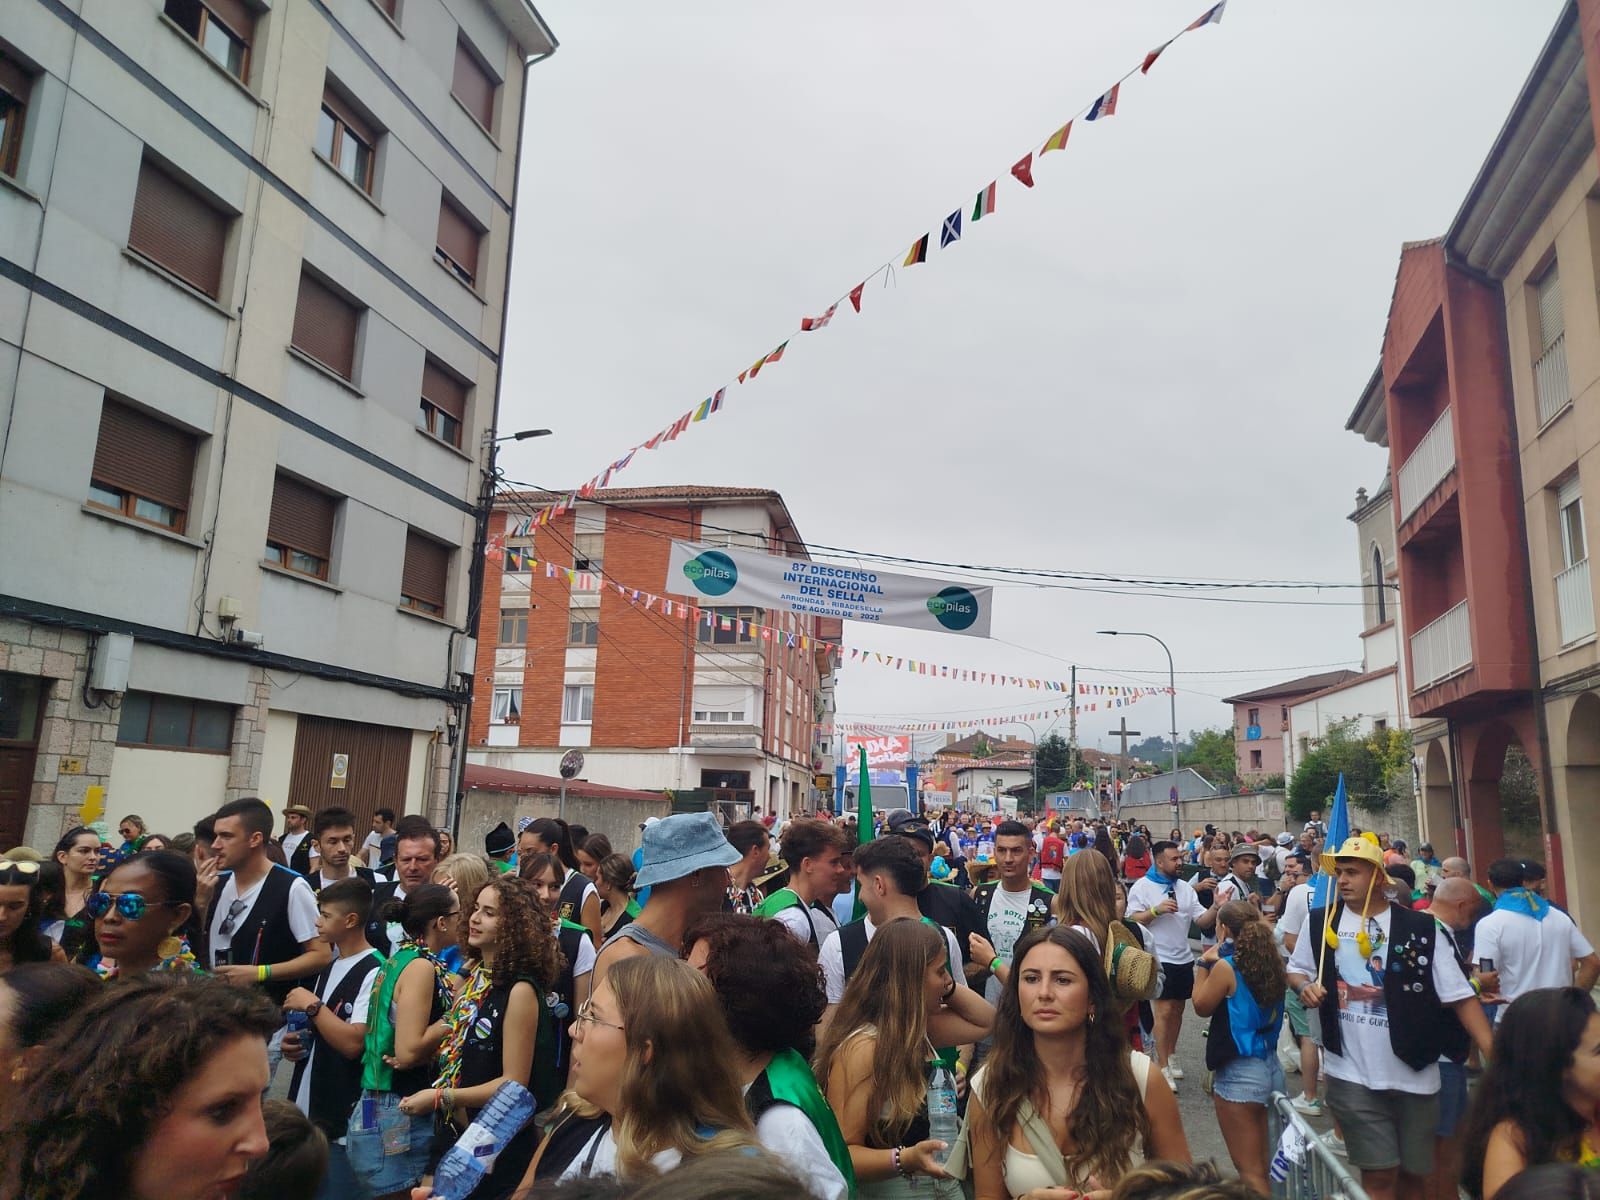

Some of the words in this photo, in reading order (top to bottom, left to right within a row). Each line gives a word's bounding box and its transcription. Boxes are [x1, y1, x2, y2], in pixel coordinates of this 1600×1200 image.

[683, 565, 730, 579] ecopilas
[792, 562, 807, 572] 87
[810, 565, 877, 583] DESCENSO
[783, 572, 884, 594] INTERNACIONAL
[780, 593, 825, 606] ARRIONDAS
[831, 601, 883, 613] RIBADESELLA
[800, 585, 823, 597] DEL
[827, 589, 865, 603] SELLA
[808, 606, 840, 616] AGOSTO
[860, 612, 880, 621] 2025
[927, 600, 971, 614] ecopilas
